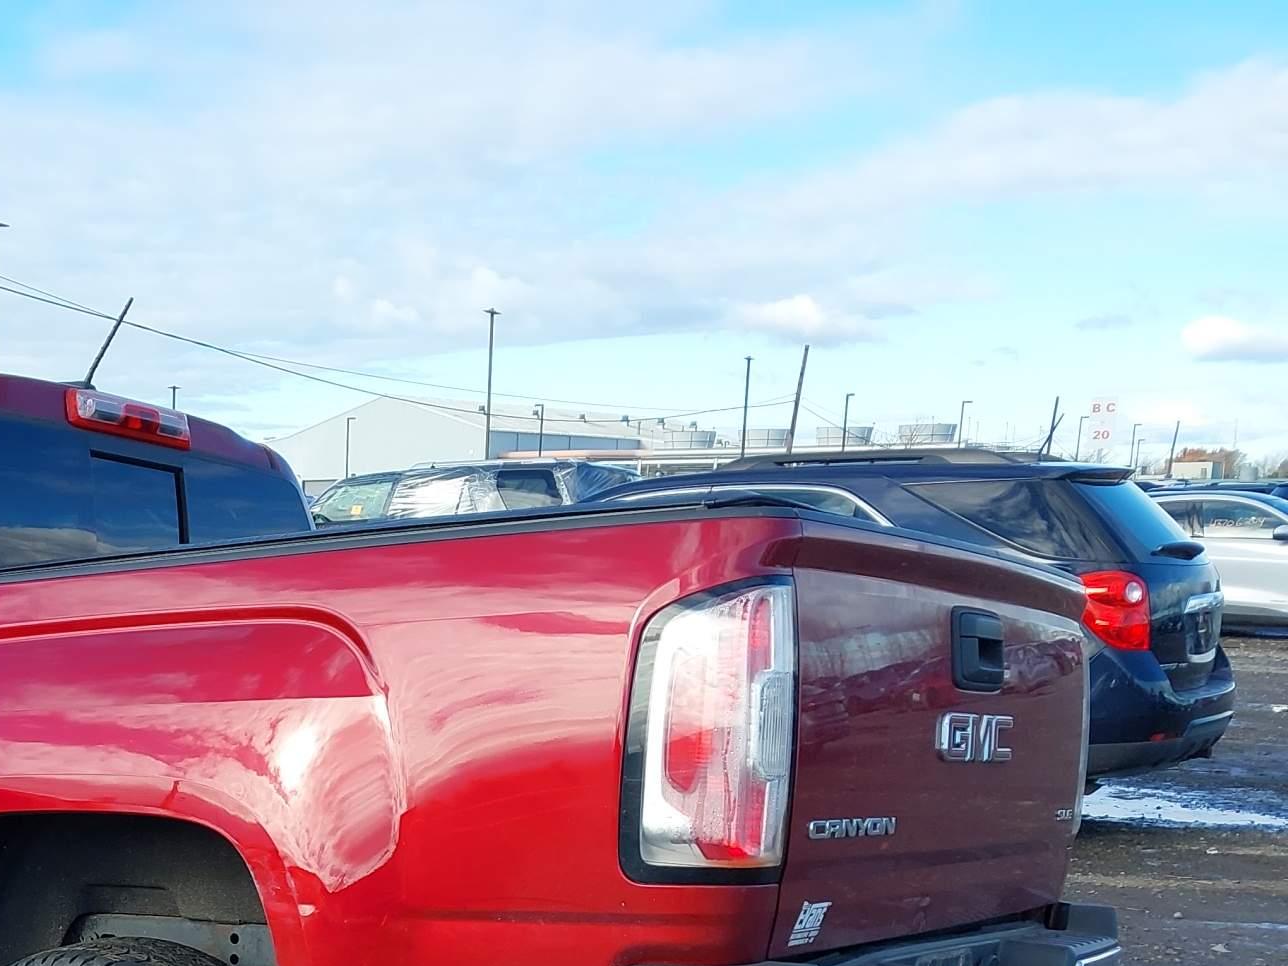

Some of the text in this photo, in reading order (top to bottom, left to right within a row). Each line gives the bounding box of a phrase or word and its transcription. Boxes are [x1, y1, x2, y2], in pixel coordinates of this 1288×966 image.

[1092, 402, 1116, 413] B C
[1092, 430, 1110, 440] 20
[935, 712, 1014, 762] GMC
[809, 817, 896, 840] CANYON
